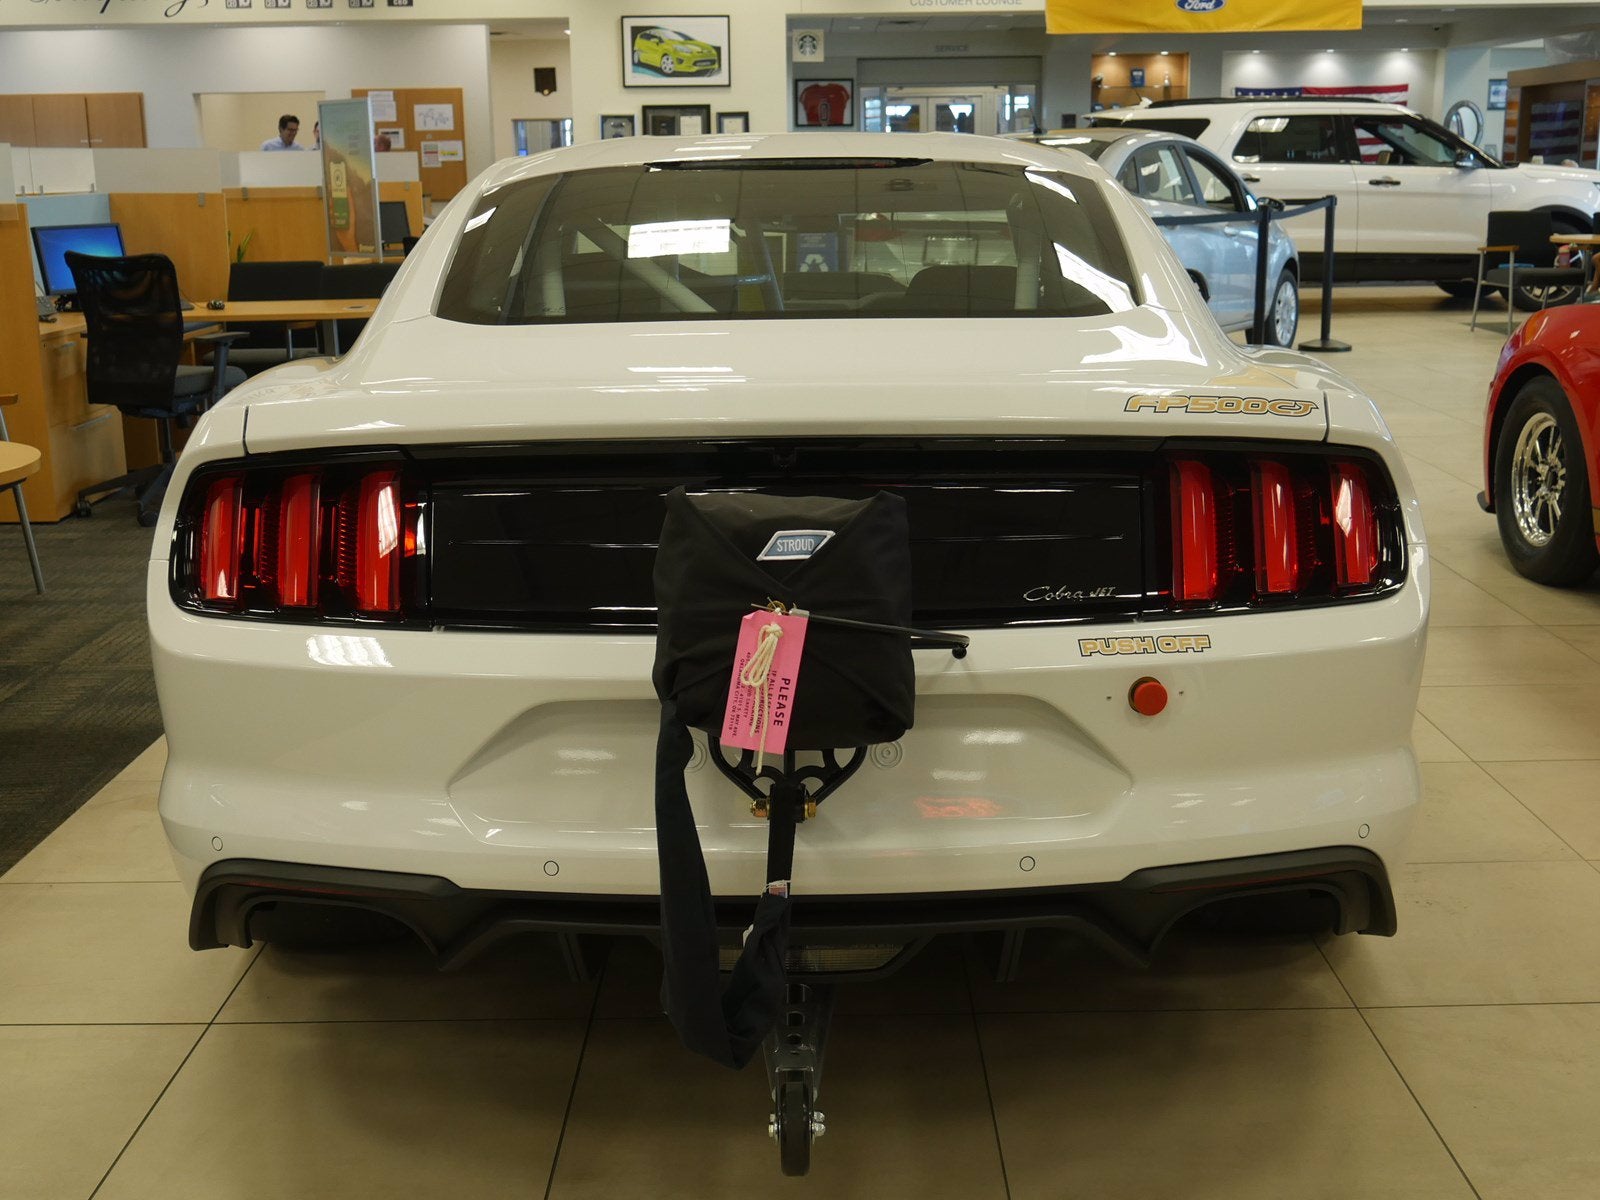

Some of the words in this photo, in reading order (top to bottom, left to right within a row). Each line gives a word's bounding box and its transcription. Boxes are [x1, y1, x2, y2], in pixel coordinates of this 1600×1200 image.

[776, 538, 815, 552] STROUD
[1023, 585, 1083, 602] Cobra
[1089, 587, 1116, 598] JET
[1078, 636, 1157, 657] PUSH
[1157, 635, 1211, 653] OFF
[773, 677, 790, 727] PLEASE
